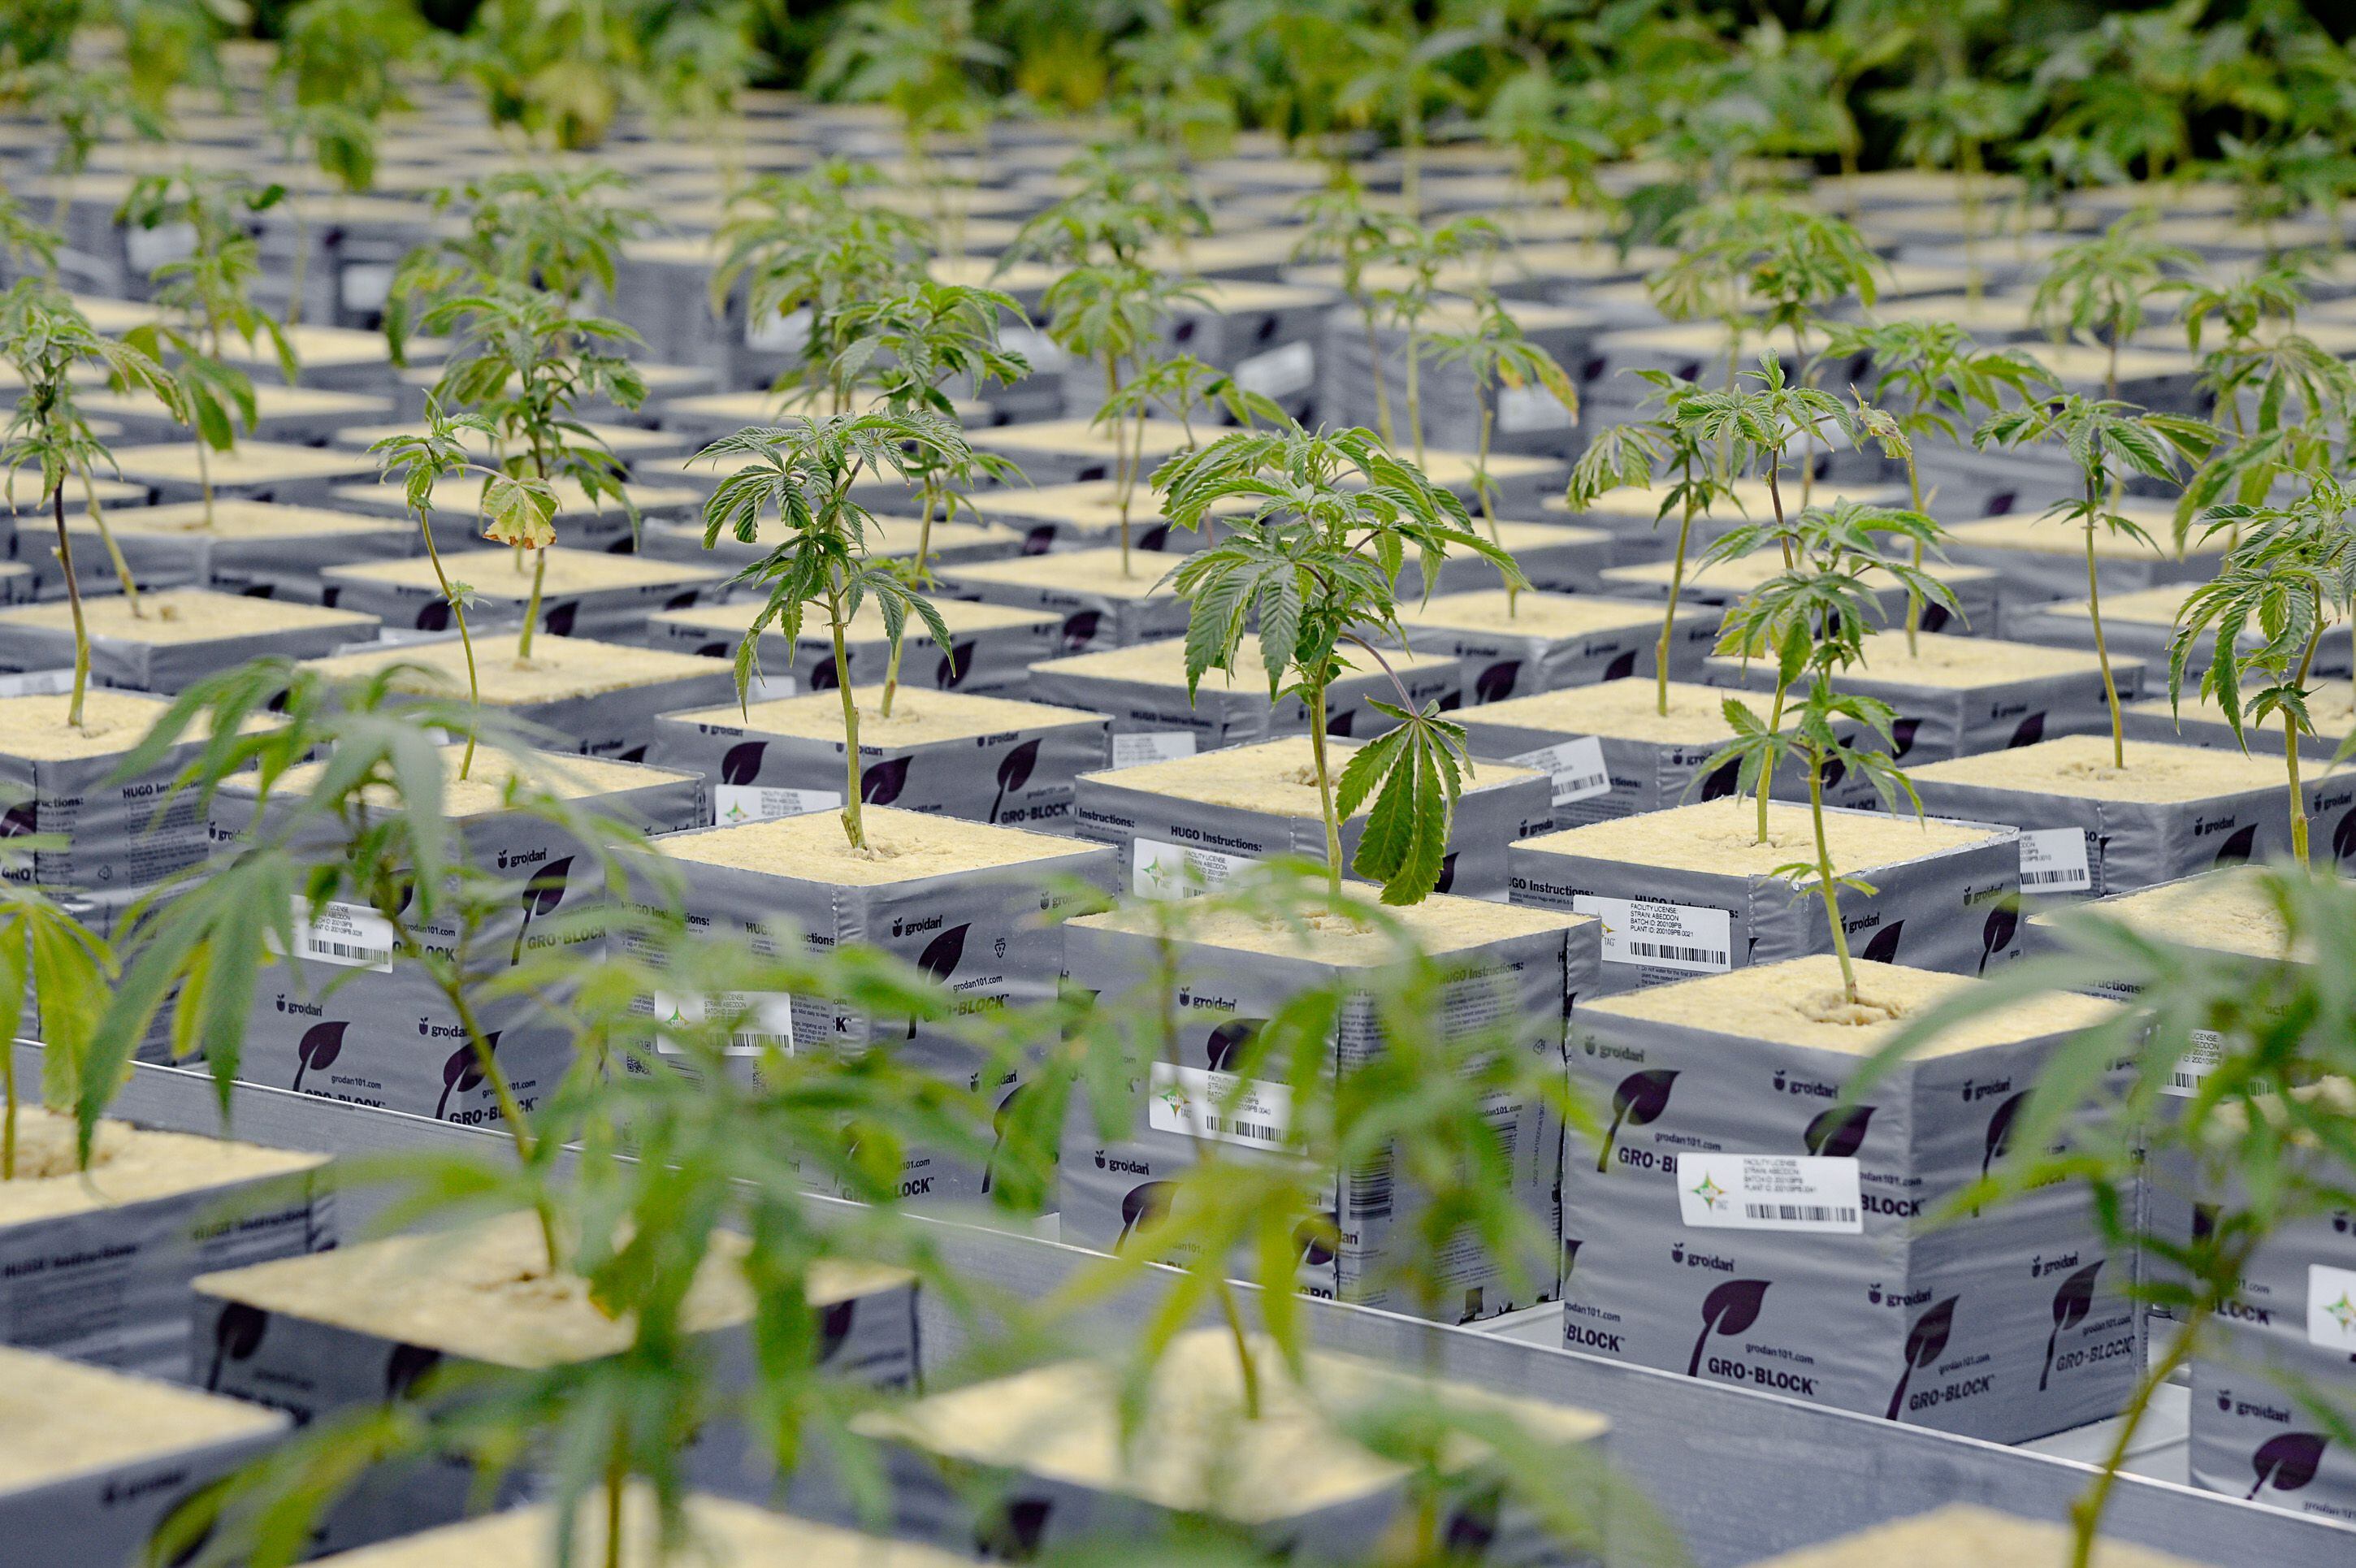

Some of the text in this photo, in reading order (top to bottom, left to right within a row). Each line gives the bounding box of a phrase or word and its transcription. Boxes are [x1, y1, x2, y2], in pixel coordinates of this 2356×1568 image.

[1079, 807, 1135, 828] Instructions:
[1530, 819, 1553, 836] groda
[1172, 825, 1200, 841] HUGO
[1203, 831, 1262, 852] Instructions:
[1631, 903, 1653, 911] FACILITY
[1652, 913, 1679, 921] ABEDDON
[1630, 925, 1648, 933] PLANT
[1849, 912, 1881, 933] grodan
[953, 975, 1003, 993] grodan101.com
[288, 1001, 323, 1016] grodan
[1193, 994, 1236, 1013] grodan
[331, 1073, 382, 1090] grodan101.com
[1655, 1130, 1722, 1153] grodan101.com
[1109, 1157, 1150, 1176] grodan
[1564, 1302, 1621, 1323] rodan101.com
[1745, 1341, 1814, 1365] grodan101.com
[2056, 1336, 2135, 1371] GRO-BLOCK
[1708, 1357, 1817, 1396] GRO-BLOCK
[1909, 1375, 1994, 1411] GRO-BLOCK
